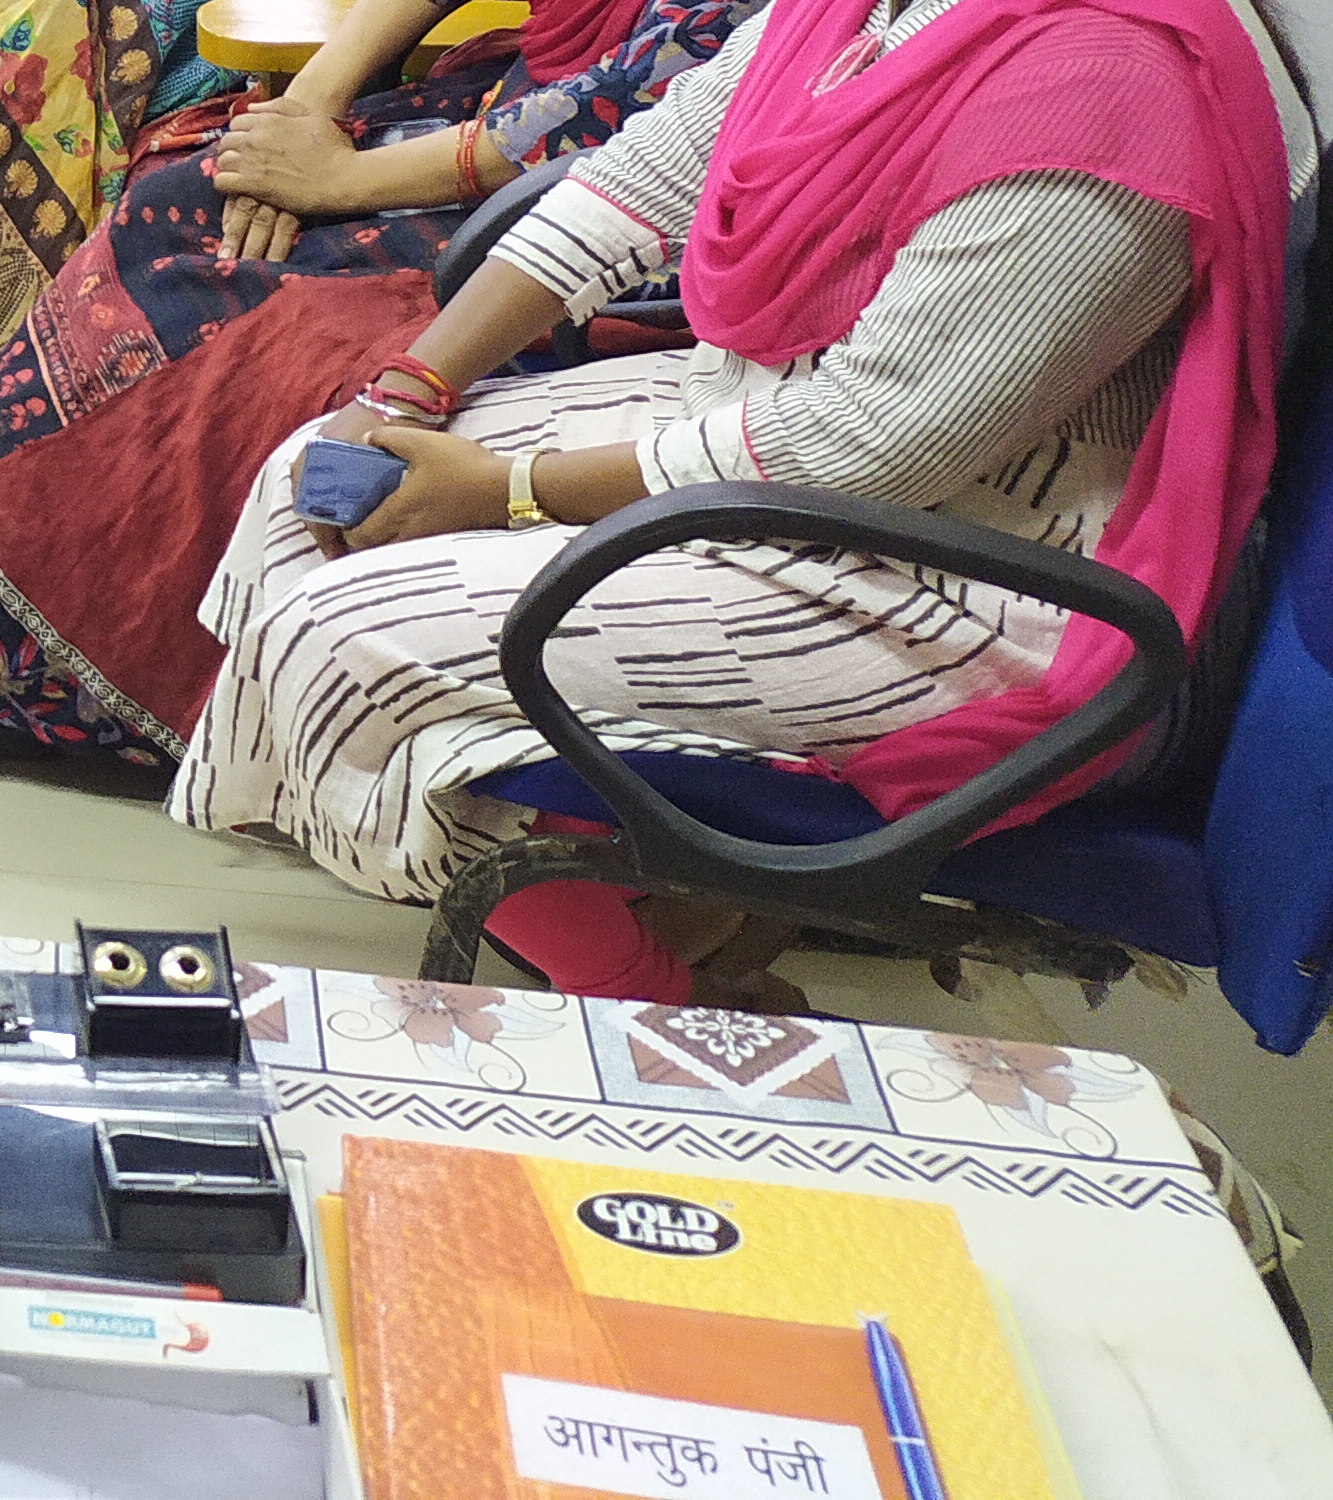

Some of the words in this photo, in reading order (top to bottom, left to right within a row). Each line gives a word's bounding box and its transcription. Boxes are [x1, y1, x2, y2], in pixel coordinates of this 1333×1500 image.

[592, 1197, 720, 1233] GOLD
[616, 1210, 718, 1251] Line
[544, 1415, 718, 1487] आगन्तुक
[743, 1437, 829, 1494] पंजी
